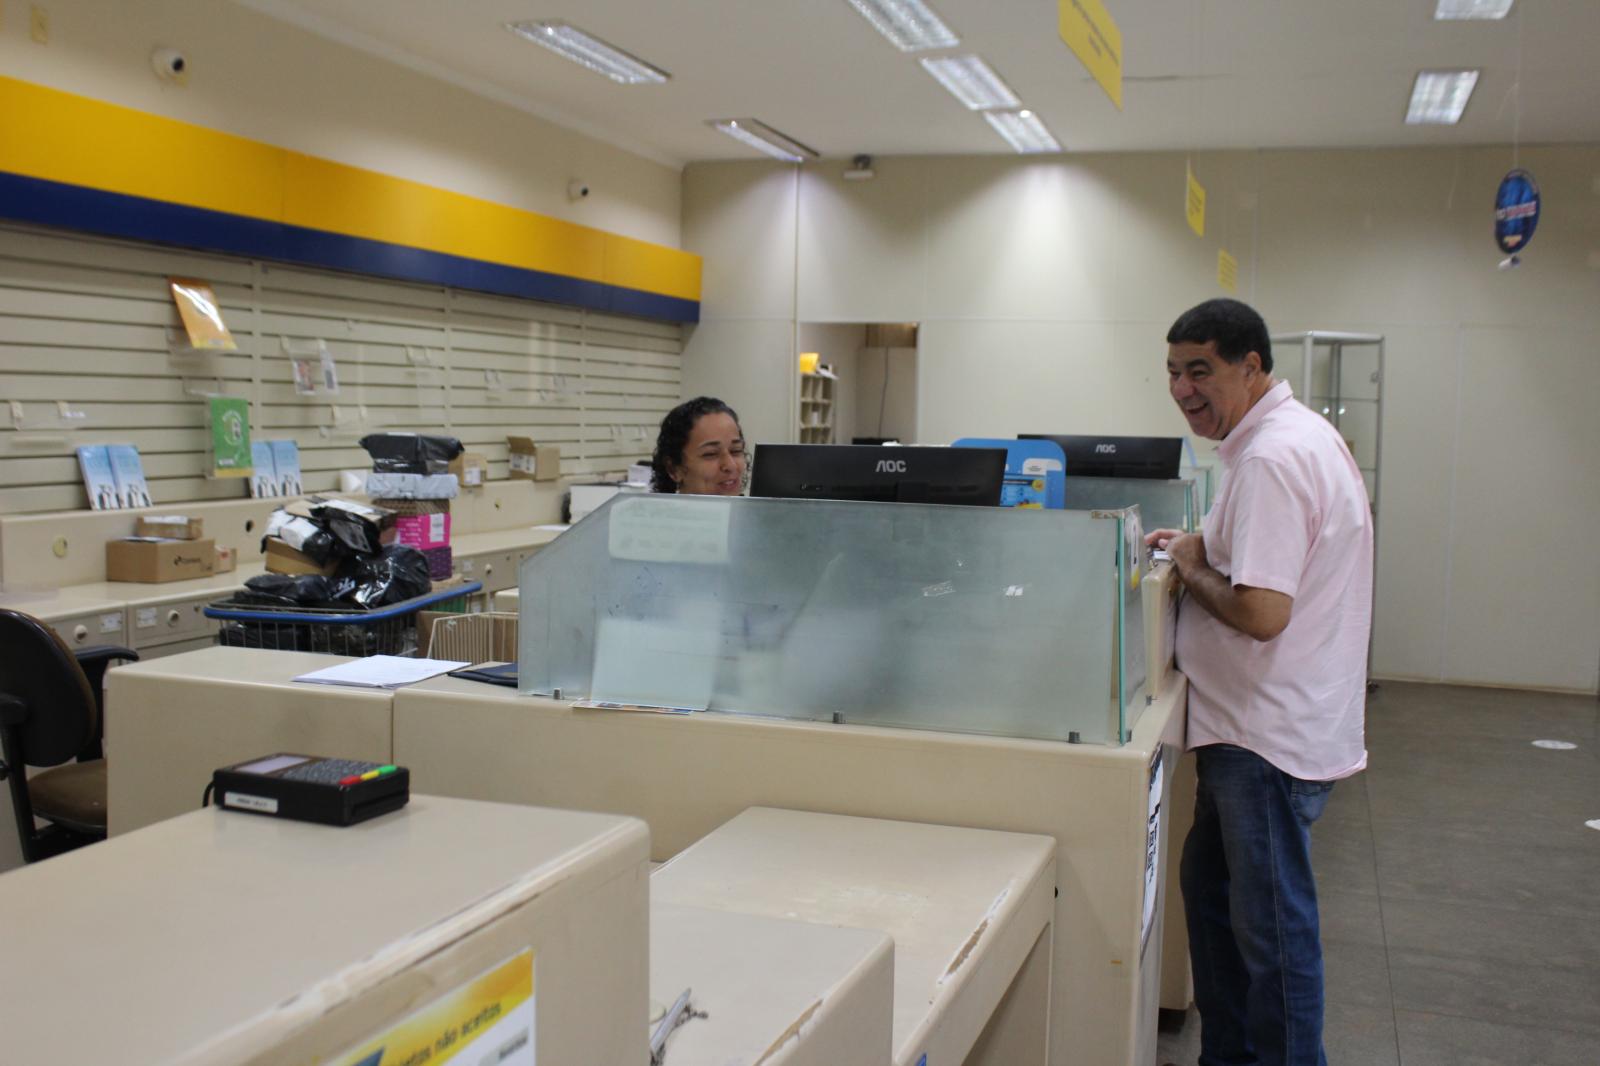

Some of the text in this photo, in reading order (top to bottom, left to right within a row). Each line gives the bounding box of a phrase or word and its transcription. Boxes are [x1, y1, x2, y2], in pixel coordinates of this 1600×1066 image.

[1095, 443, 1117, 454] AOC
[875, 459, 907, 473] AOC
[435, 1027, 458, 1055] não
[461, 1002, 501, 1038] aceitos
